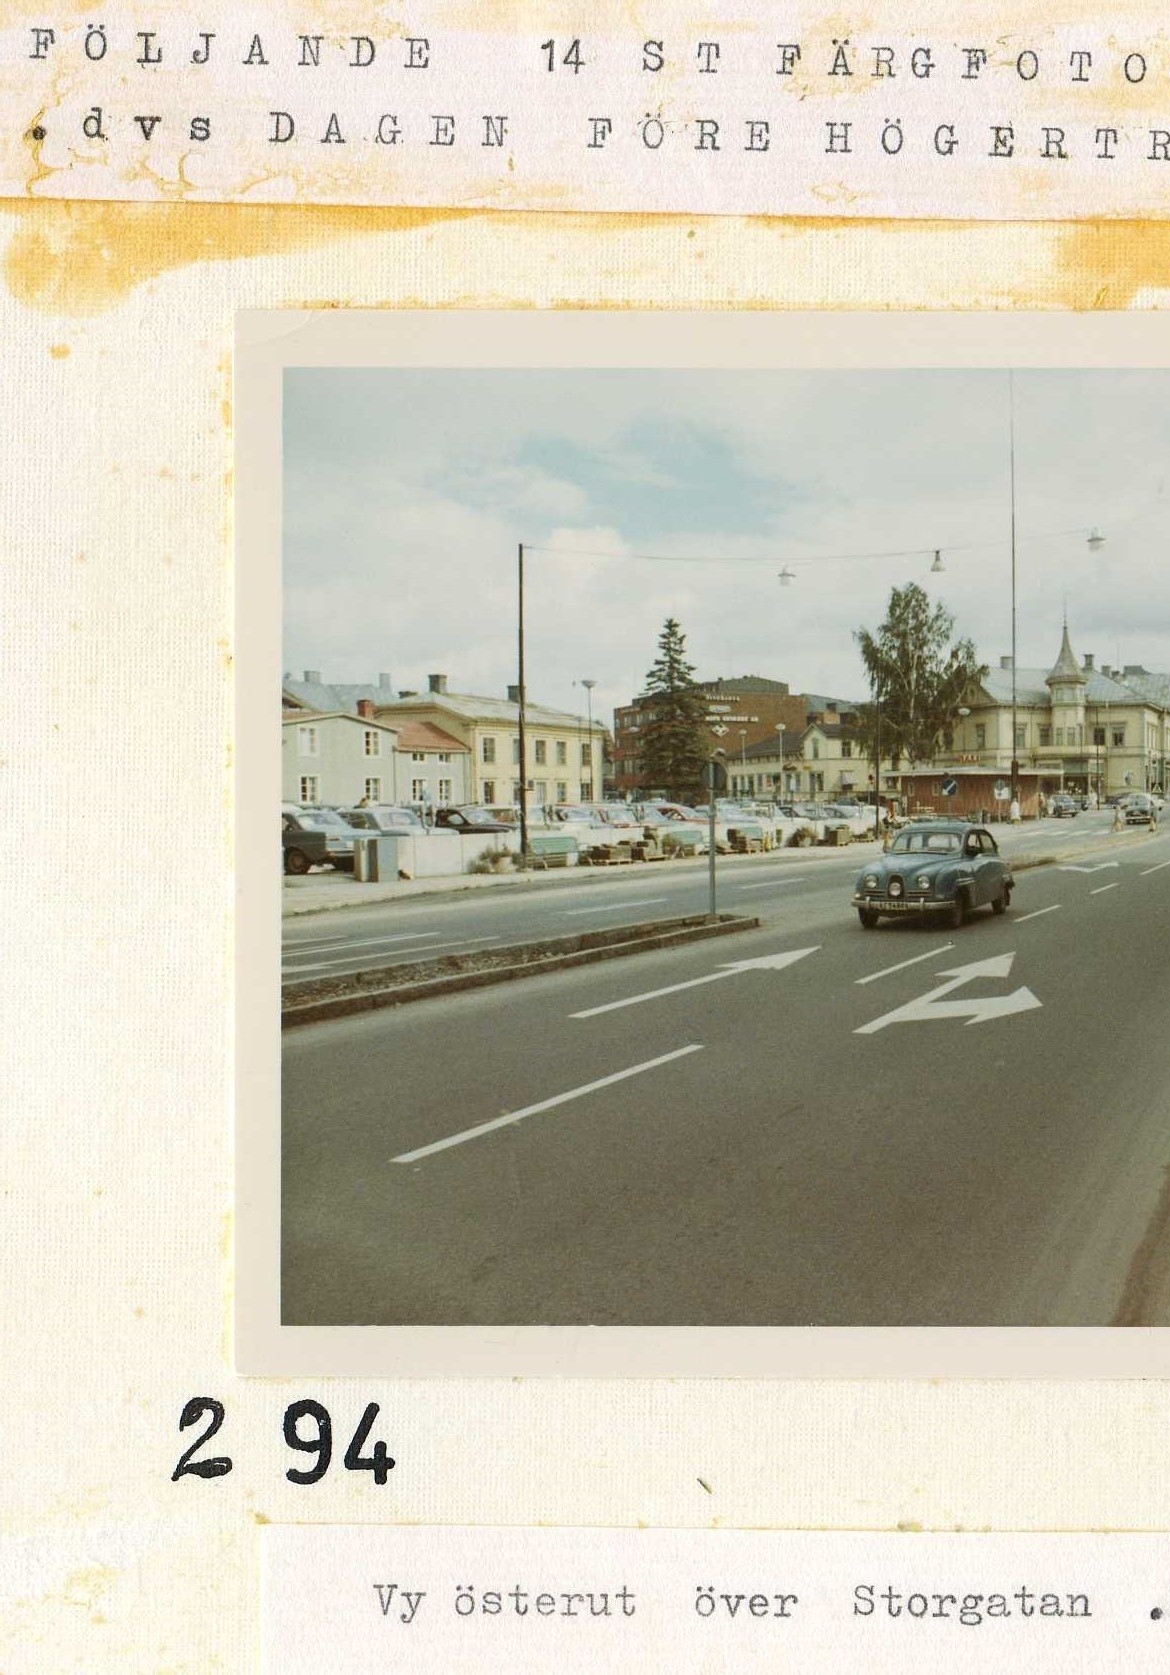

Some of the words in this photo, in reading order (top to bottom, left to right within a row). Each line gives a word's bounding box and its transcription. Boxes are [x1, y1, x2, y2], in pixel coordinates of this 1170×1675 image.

[30, 24, 432, 69] FÖLJANDE
[541, 40, 585, 74] 14
[642, 39, 720, 74] ST
[269, 112, 510, 148] DAGEN
[587, 112, 771, 152] FÖRE
[373, 1584, 426, 1624] Vy
[455, 1585, 636, 1618] österut
[695, 1586, 798, 1618] över
[853, 1585, 1093, 1626] Storgatan
